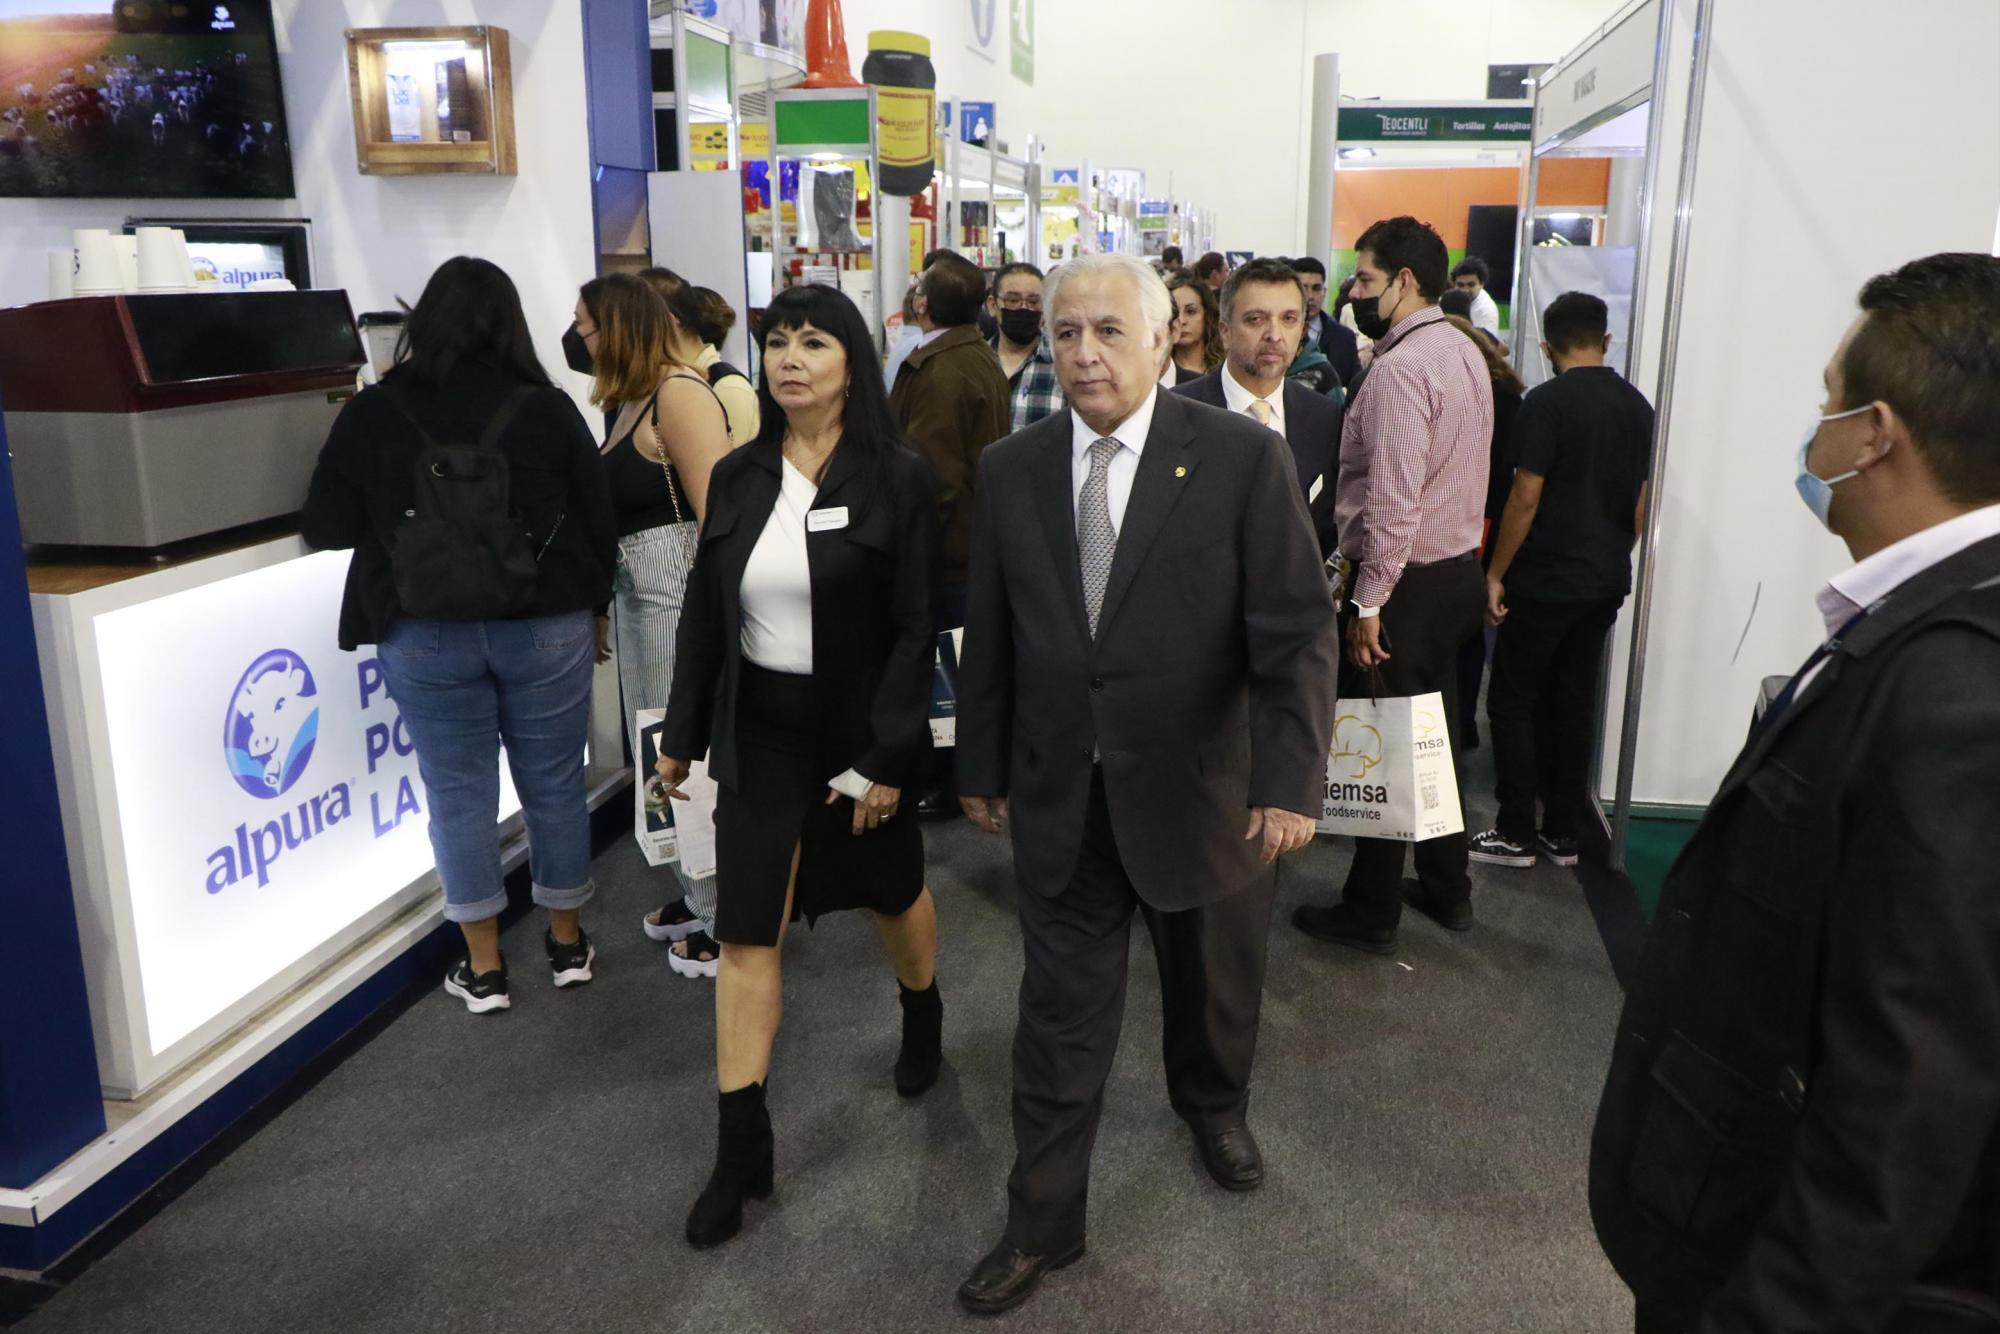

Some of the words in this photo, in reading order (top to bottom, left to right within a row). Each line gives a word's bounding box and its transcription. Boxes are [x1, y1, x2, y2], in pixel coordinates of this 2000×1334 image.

[1376, 113, 1429, 131] TEOCENTLI
[1452, 121, 1486, 131] Tortillas
[1493, 121, 1532, 133] Antojitos
[357, 658, 392, 710] P
[369, 774, 422, 839] LA
[205, 781, 351, 897] alpura
